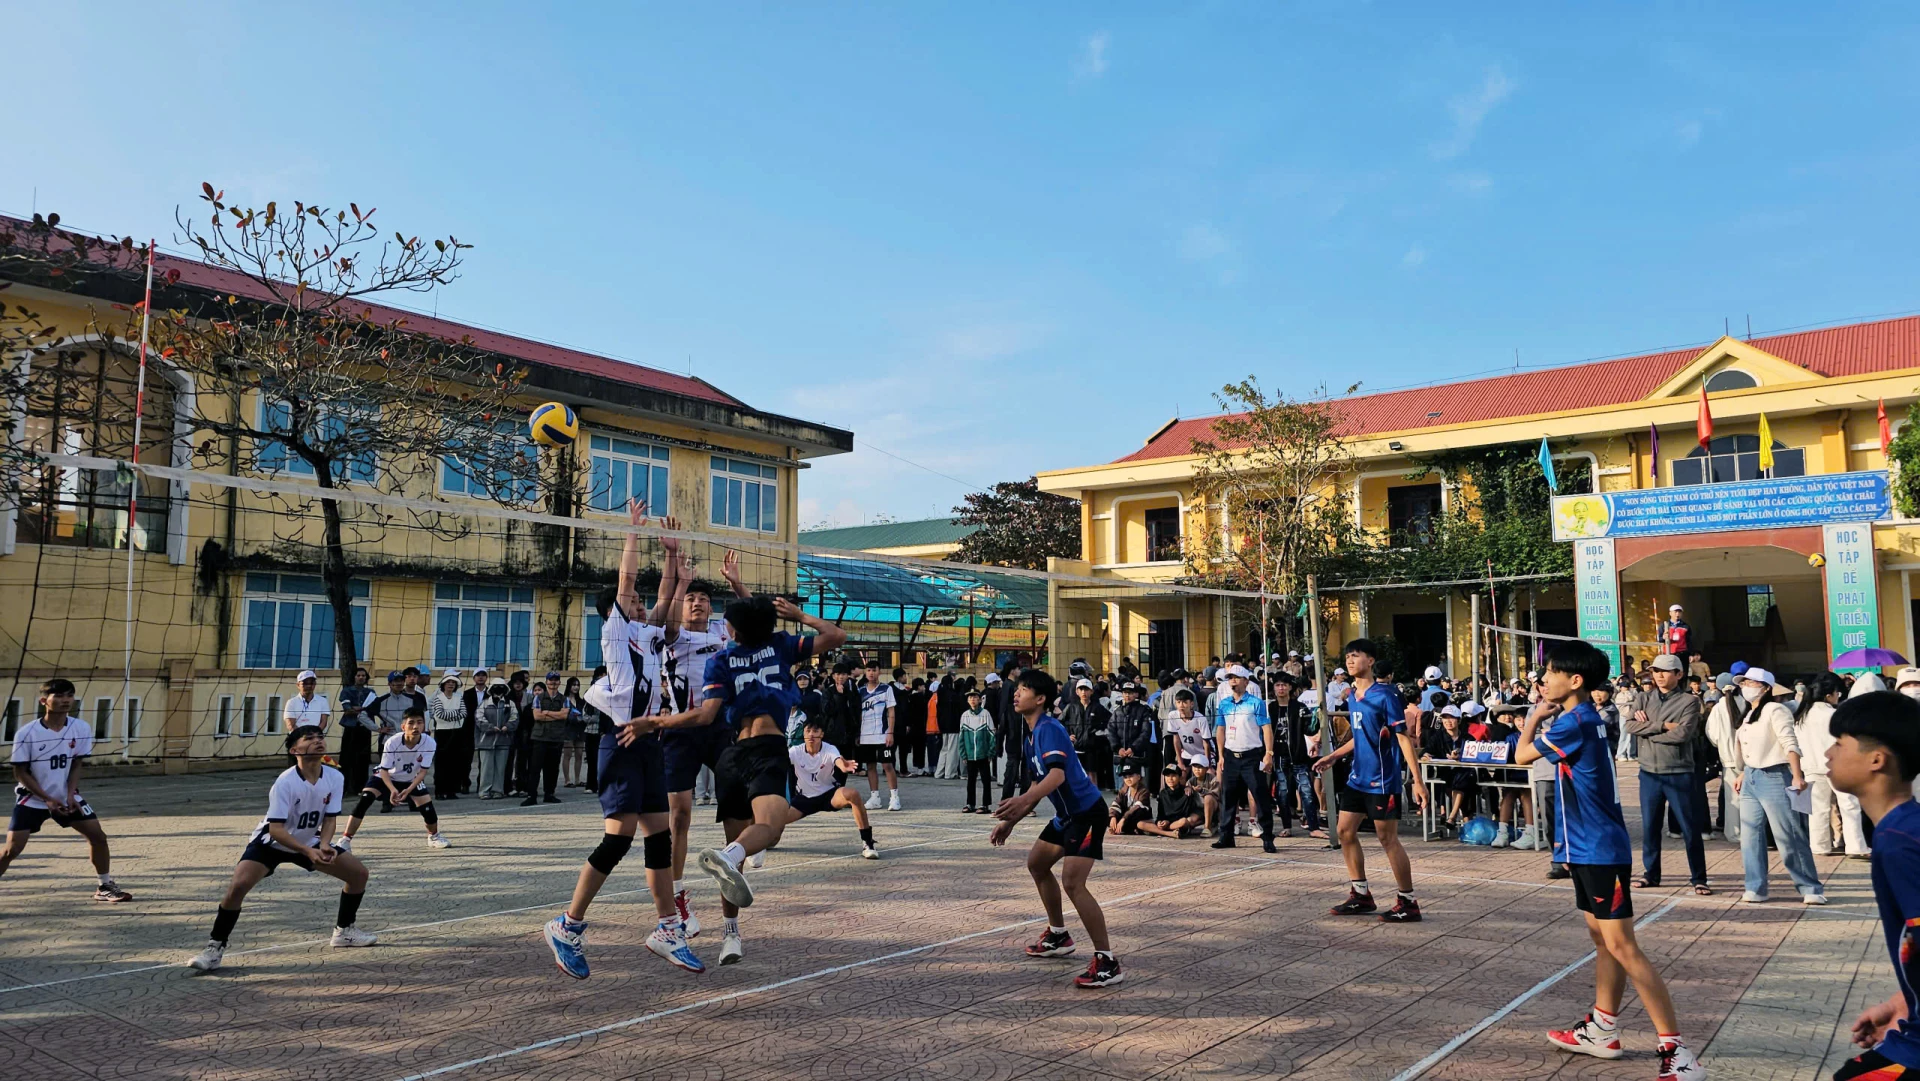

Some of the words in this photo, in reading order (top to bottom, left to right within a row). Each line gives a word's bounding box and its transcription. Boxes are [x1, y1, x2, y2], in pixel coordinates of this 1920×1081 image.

[1690, 492, 1698, 500] CÓ
[1715, 490, 1728, 498] NÊN
[1764, 487, 1778, 495] HAY
[1807, 484, 1822, 492] DÂN
[1824, 482, 1838, 492] TỘC
[1840, 480, 1856, 490] VIỆT
[1858, 480, 1876, 488] NAM
[1617, 508, 1626, 517] CÓ
[1671, 505, 1687, 513] VINH
[1688, 503, 1712, 512] QUANG
[1724, 500, 1742, 509] SÁNH
[1744, 500, 1756, 508] VAI
[1772, 496, 1786, 506] CÁC
[1814, 492, 1835, 504] QUỐC
[1836, 492, 1852, 502] NĂM
[1854, 490, 1876, 500] CHÂU
[1636, 519, 1648, 527] HAY
[1675, 515, 1696, 524] CHÍNH
[1697, 514, 1705, 522] LÀ
[1758, 510, 1773, 518] LỚN
[1781, 507, 1800, 518] CÔNG
[1802, 506, 1817, 517] HỌC
[1818, 504, 1832, 516] TẬP
[1833, 504, 1848, 514] CỦA
[1850, 502, 1864, 512] CÁC
[1837, 531, 1858, 546] HỌC
[1586, 545, 1604, 556] HỌC
[1838, 549, 1859, 566] TẬP
[1587, 558, 1604, 572] TẬP
[1590, 572, 1602, 584] ĐỂ
[1844, 568, 1857, 584] ĐỂ
[1838, 590, 1866, 604] PHÁT
[1585, 605, 1612, 617] THIỆN
[1837, 608, 1870, 625] TRIỂN
[1586, 619, 1611, 630] NHÂN
[1844, 631, 1866, 648] QUÊ
[1352, 711, 1363, 730] 12
[1466, 744, 1476, 757] 12
[1493, 745, 1506, 758] 22
[297, 810, 320, 830] 09
